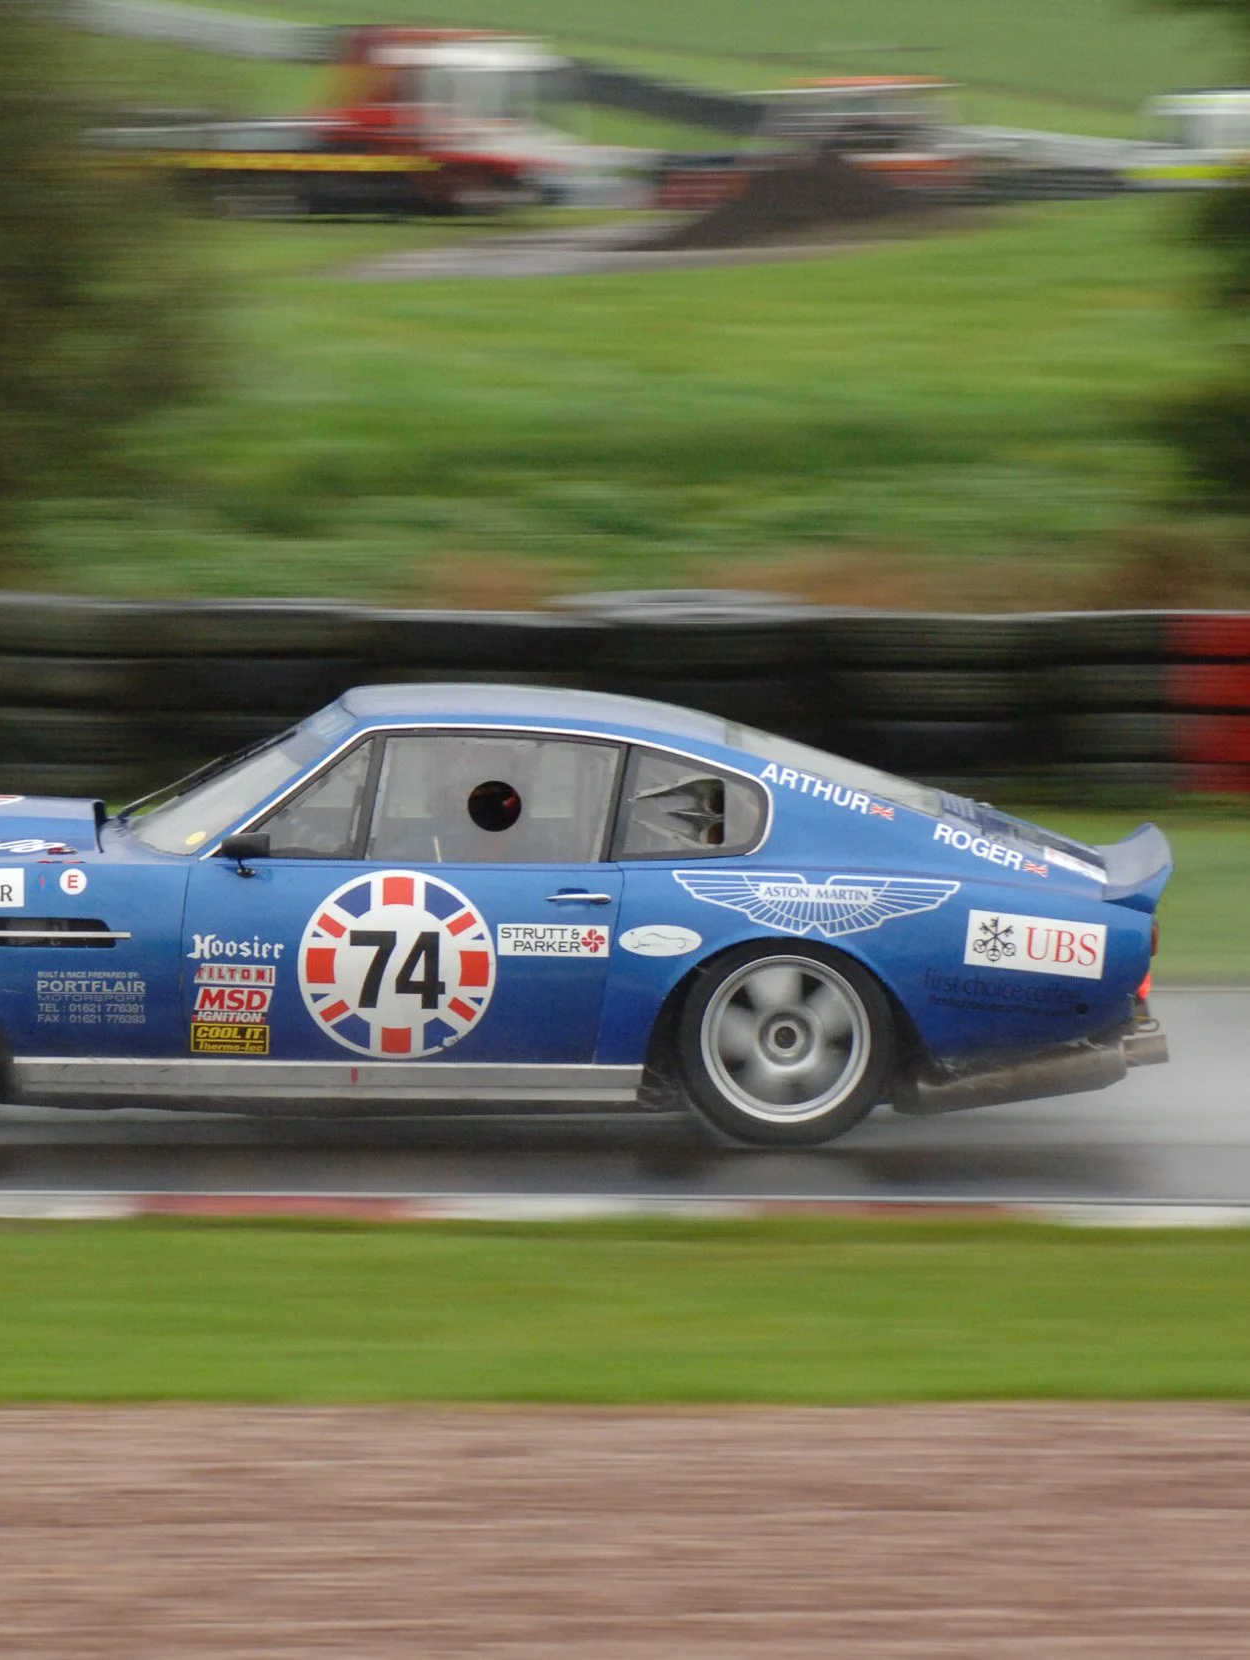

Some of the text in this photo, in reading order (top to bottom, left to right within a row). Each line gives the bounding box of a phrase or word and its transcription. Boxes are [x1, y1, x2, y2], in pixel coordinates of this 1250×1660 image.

[759, 762, 871, 815] ARTHUR
[932, 822, 1024, 870] ROGER
[67, 874, 78, 889] E
[763, 886, 869, 900] ASTON MARTIN
[500, 927, 580, 939] STRUTT &
[187, 934, 285, 959] Hoosier
[513, 940, 581, 953] PARKER
[1026, 926, 1098, 966] UBS
[349, 929, 447, 1011] 74
[37, 980, 146, 992] PORTFLAIR
[37, 994, 146, 1002] MOTORSPORT
[198, 988, 267, 1011] MSD
[38, 1003, 60, 1012] TEL
[69, 1003, 102, 1013] 01621
[37, 1014, 60, 1023] FAX
[69, 1014, 102, 1024] 01621
[197, 1011, 262, 1023] IGNITION
[196, 1026, 241, 1039] COOL
